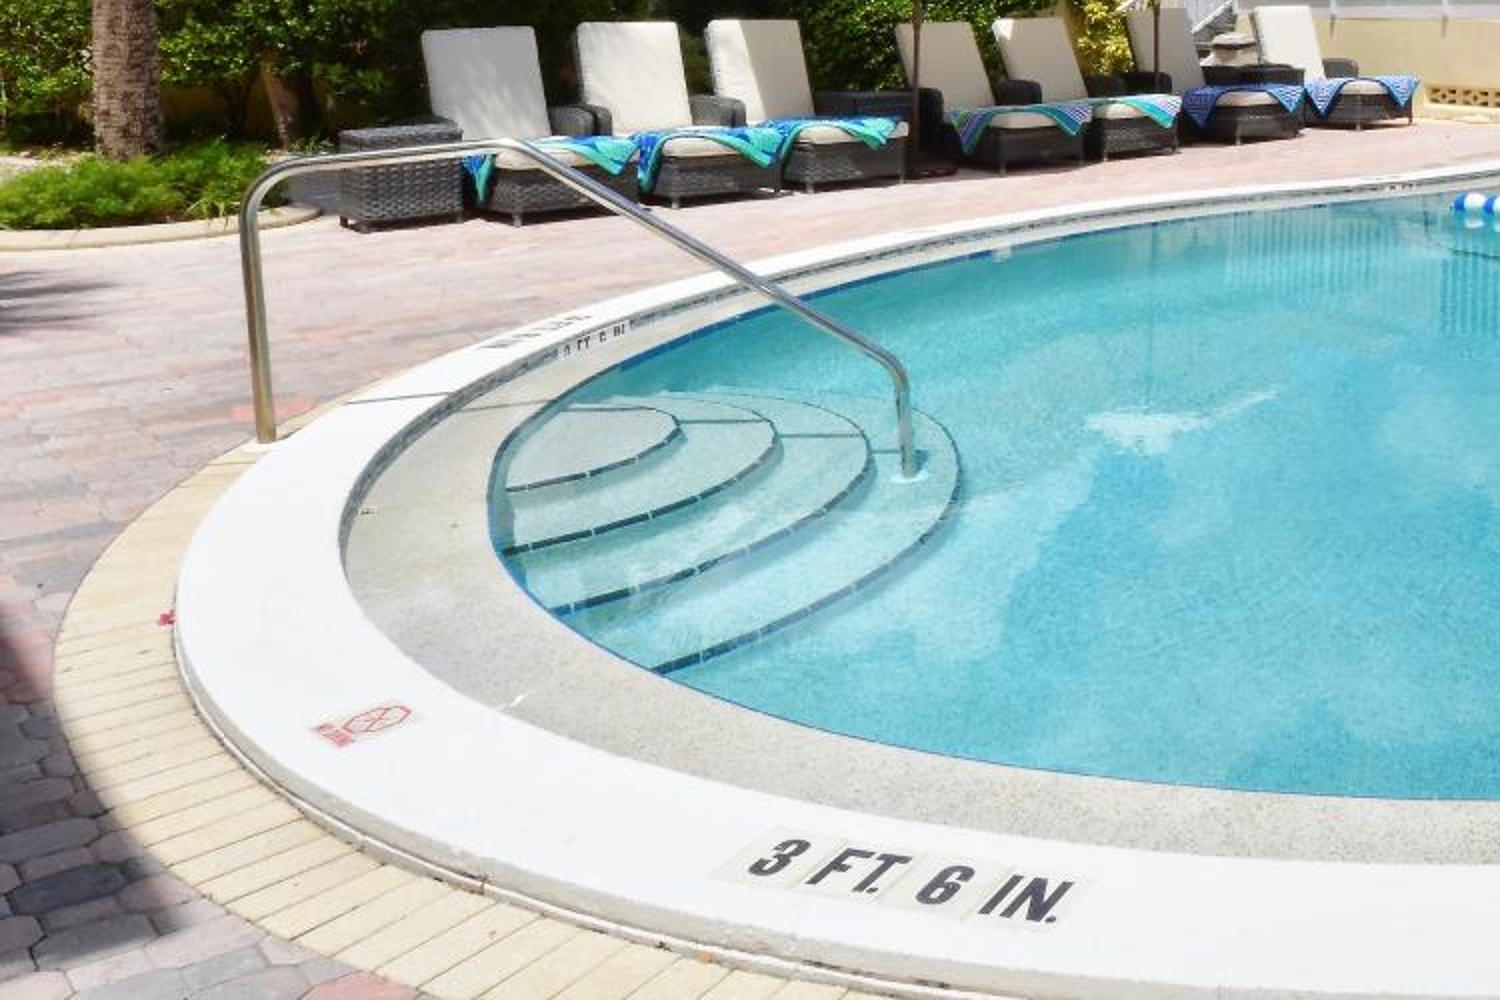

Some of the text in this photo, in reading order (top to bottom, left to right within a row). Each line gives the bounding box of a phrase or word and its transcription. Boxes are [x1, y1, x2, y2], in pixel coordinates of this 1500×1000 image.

[748, 839, 1074, 923] 3 FT. 6 IN.
